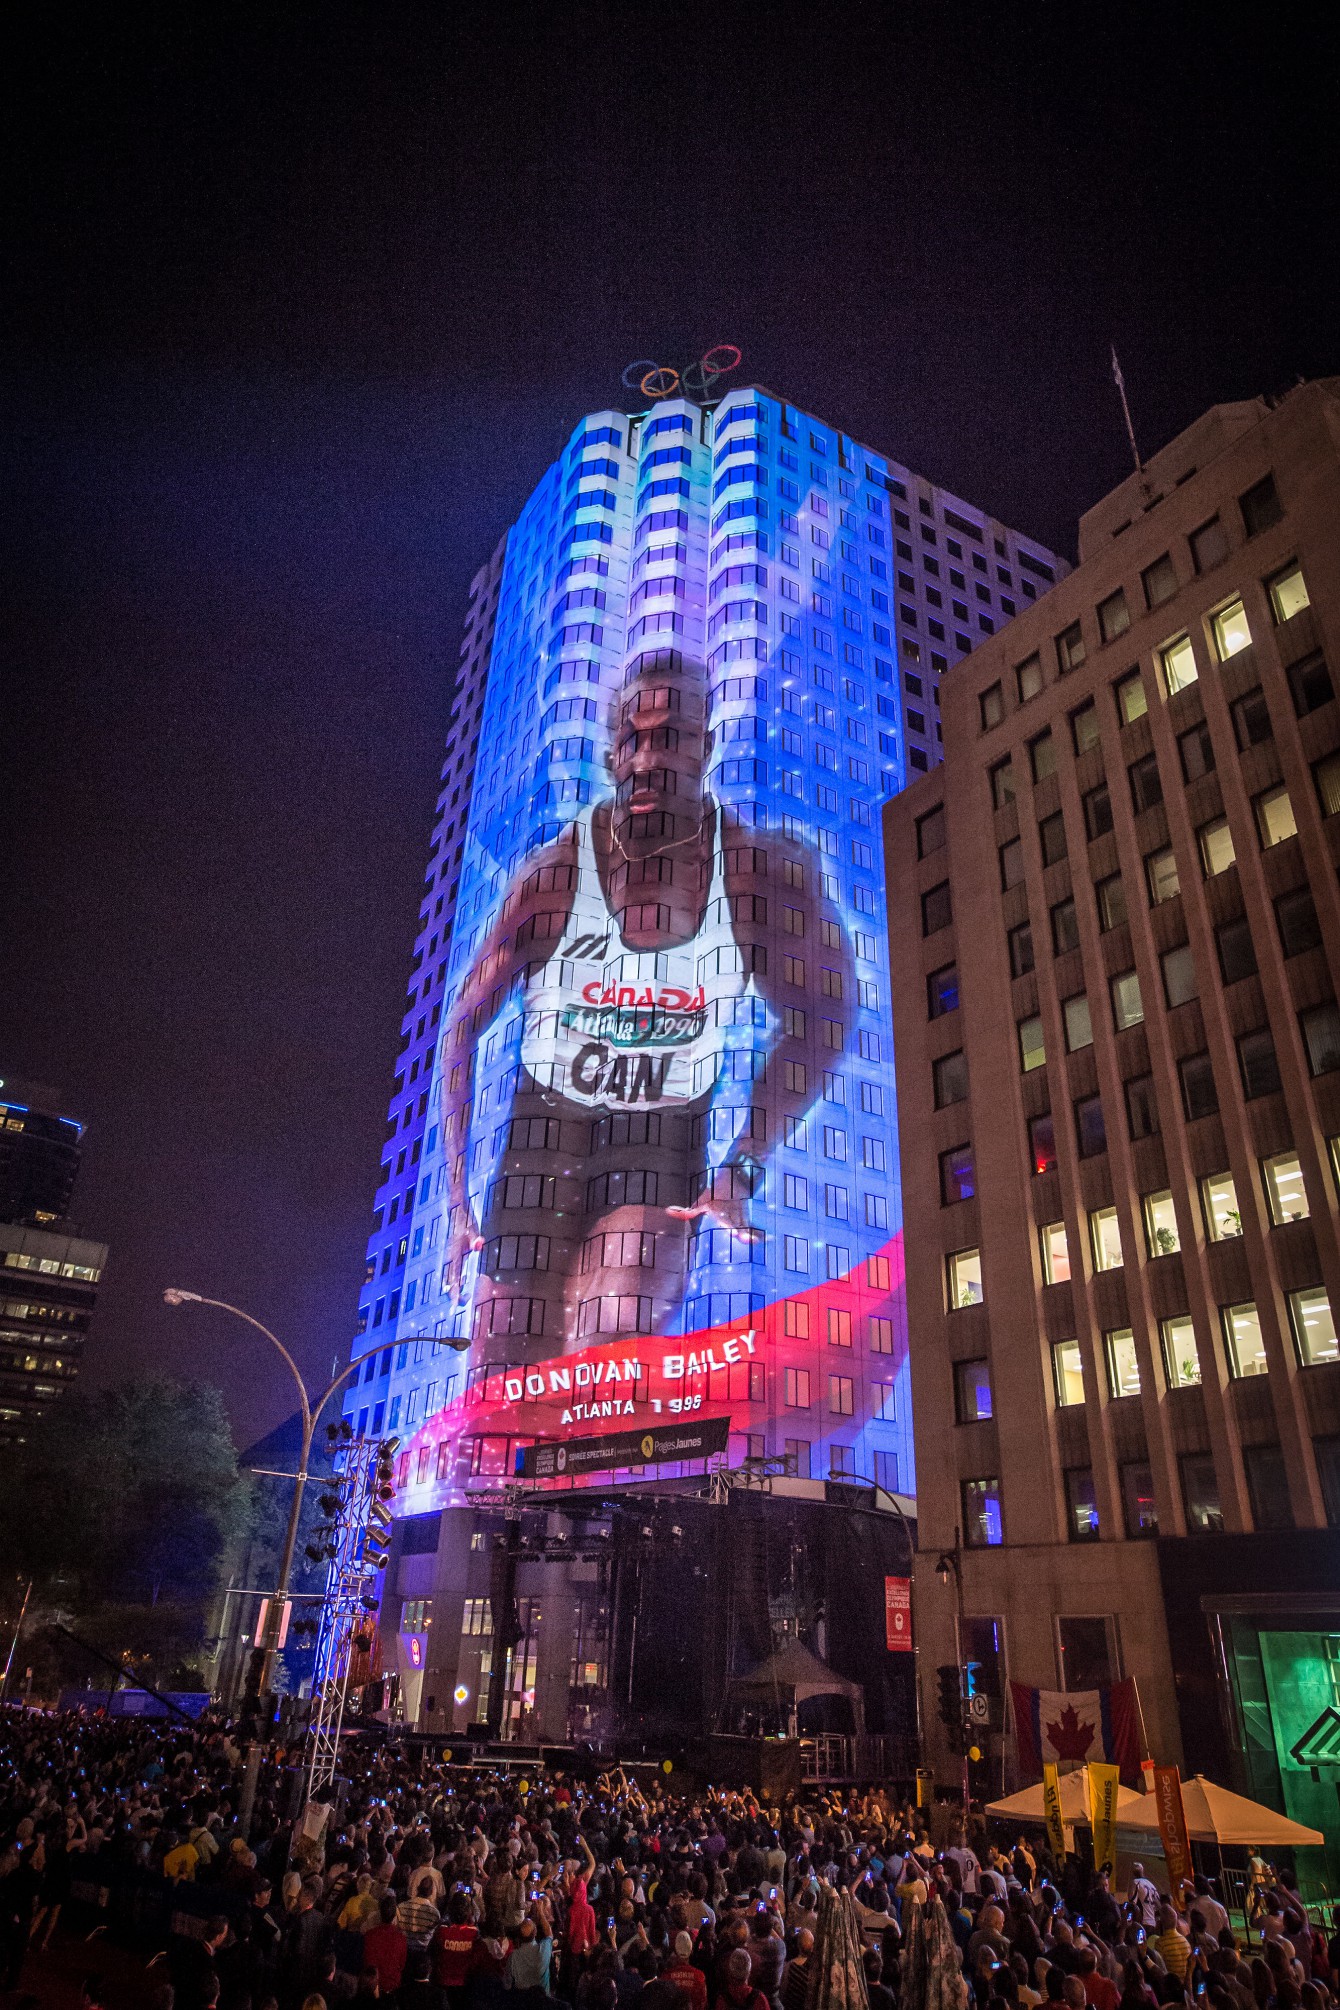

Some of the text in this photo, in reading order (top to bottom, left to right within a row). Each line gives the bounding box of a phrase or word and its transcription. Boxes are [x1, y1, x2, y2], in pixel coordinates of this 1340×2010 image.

[582, 978, 706, 1011] CANADA
[570, 1041, 676, 1103] CAN
[505, 1329, 756, 1401] DONOVAN BAILEY
[560, 1399, 635, 1425] ATLANTA
